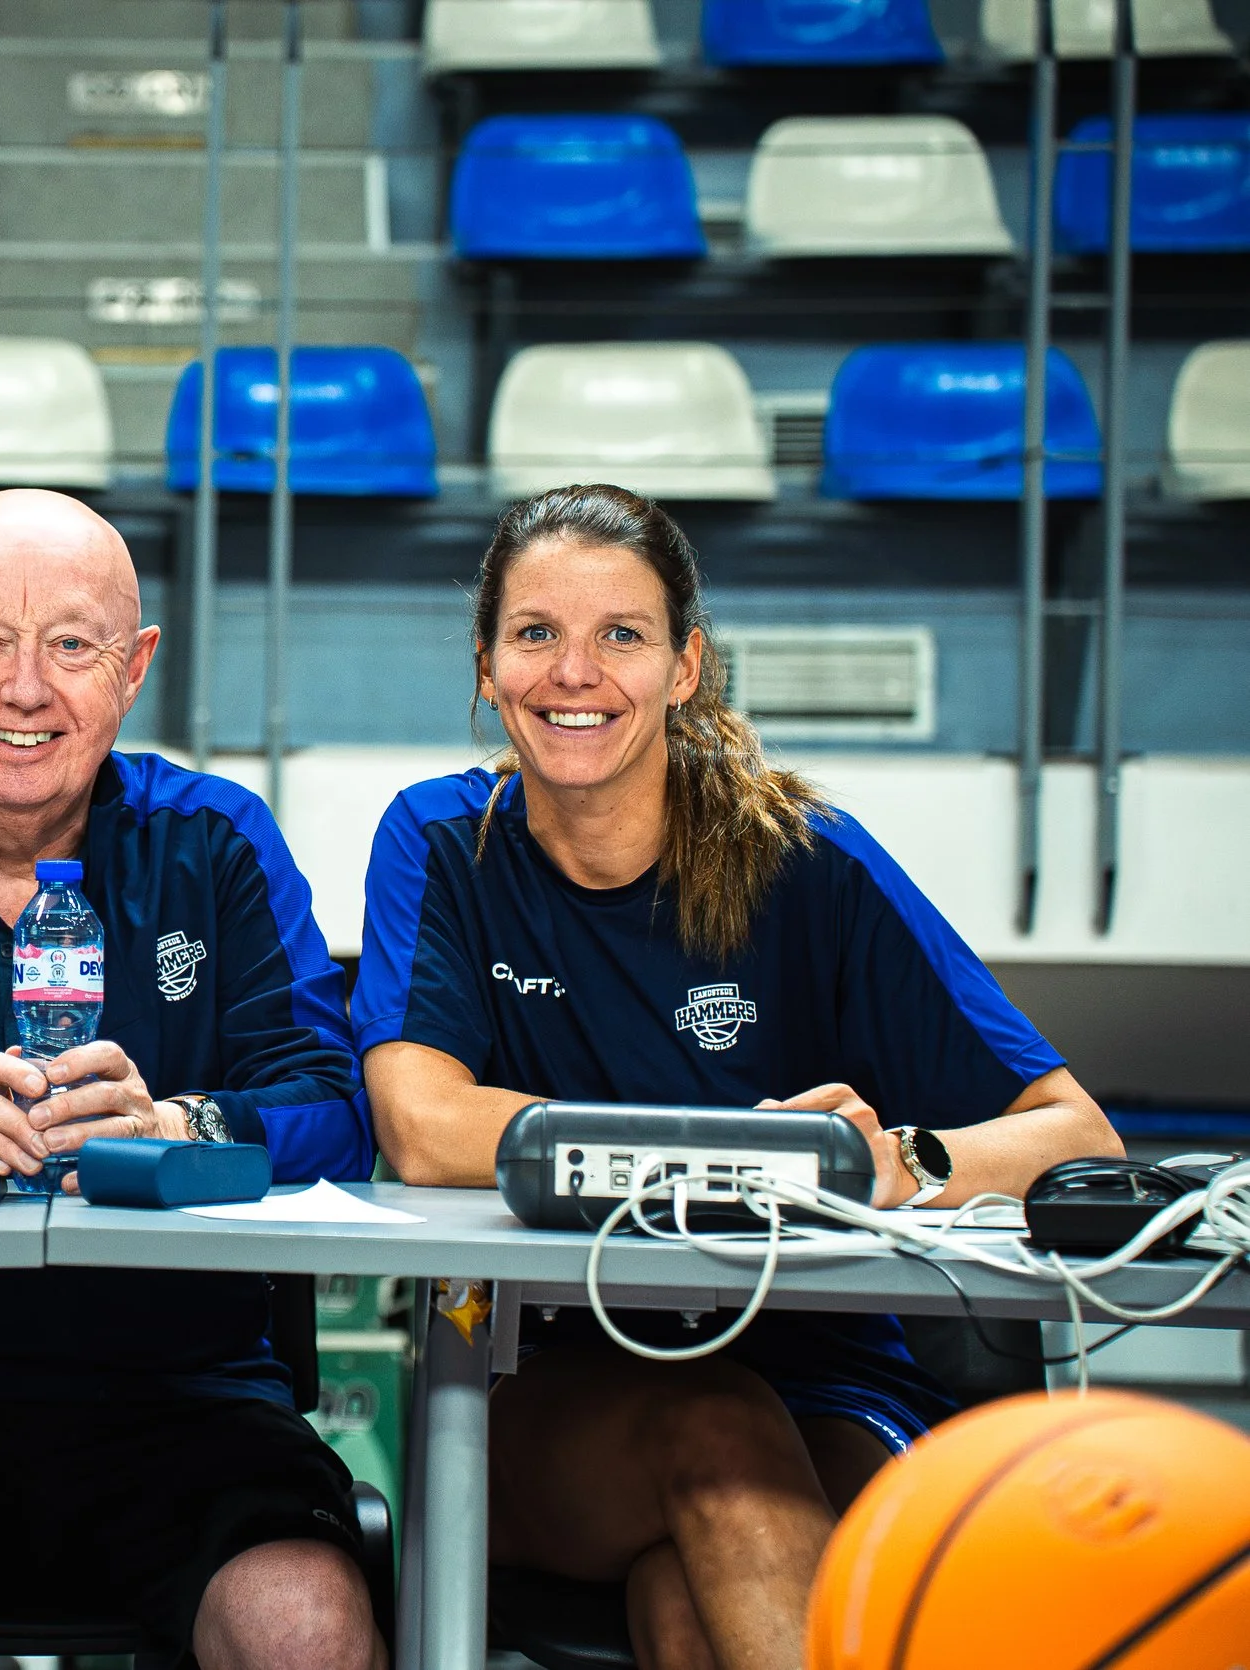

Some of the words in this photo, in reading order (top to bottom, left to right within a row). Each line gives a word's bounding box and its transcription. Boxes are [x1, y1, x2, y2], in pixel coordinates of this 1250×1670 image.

[164, 978, 198, 1002] ZWOLLE
[693, 987, 735, 1001] LANDSTEDE
[674, 999, 758, 1031] HAMMERS
[698, 1036, 738, 1051] ZWOLLE
